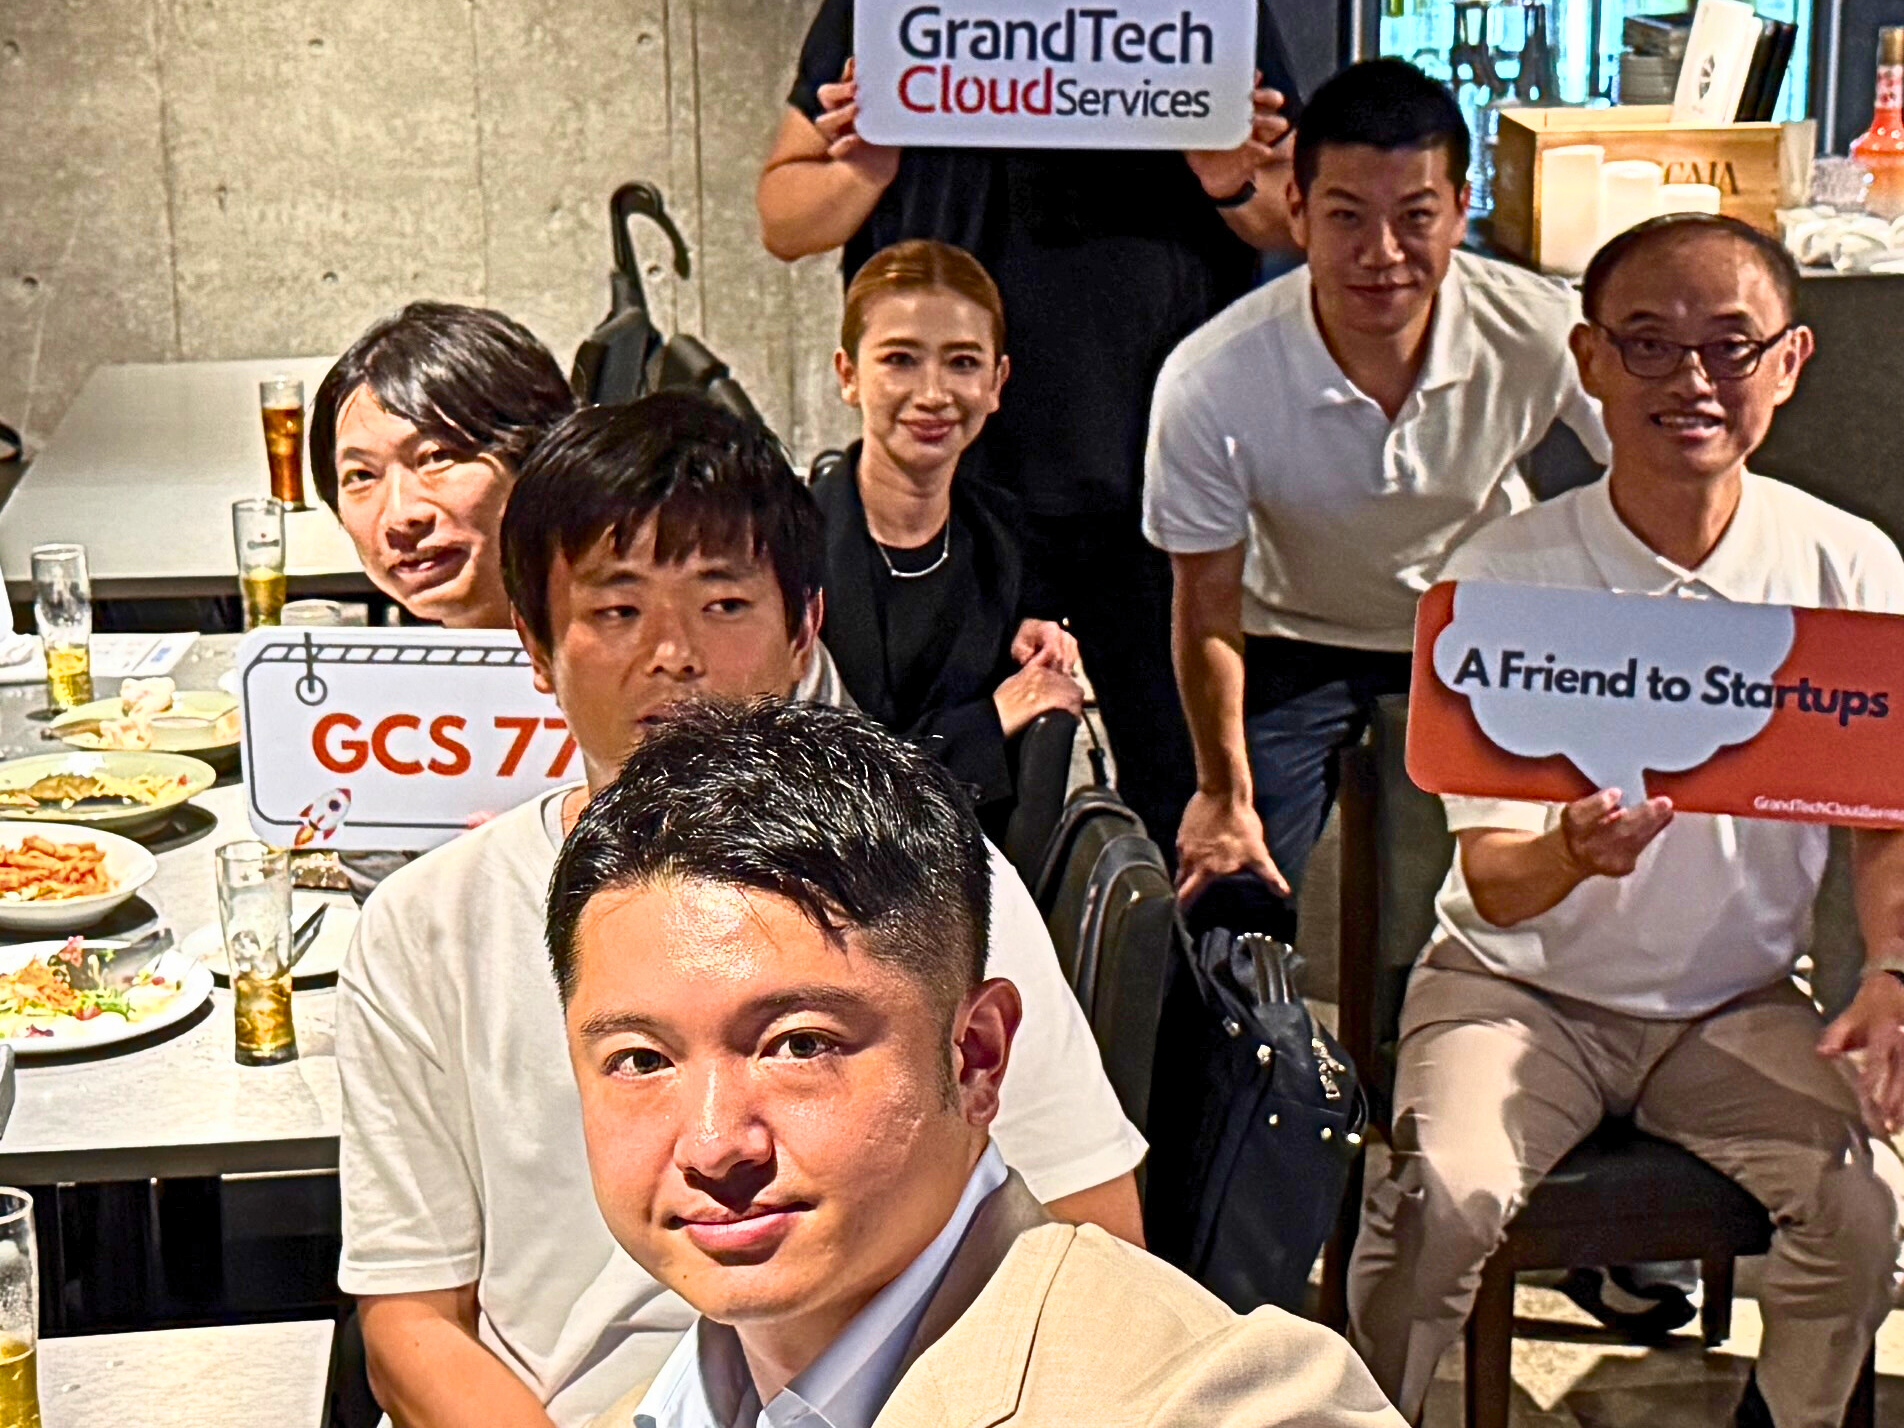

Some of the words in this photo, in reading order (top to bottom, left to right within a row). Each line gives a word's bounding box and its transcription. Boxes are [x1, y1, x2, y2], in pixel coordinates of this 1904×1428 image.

[899, 5, 1213, 64] GrandTech
[897, 65, 1211, 118] CloudServices
[1453, 647, 1489, 688] A
[1499, 650, 1638, 699] Friend
[1648, 666, 1691, 703] to
[1700, 664, 1890, 728] Startups
[311, 712, 473, 778] GCS
